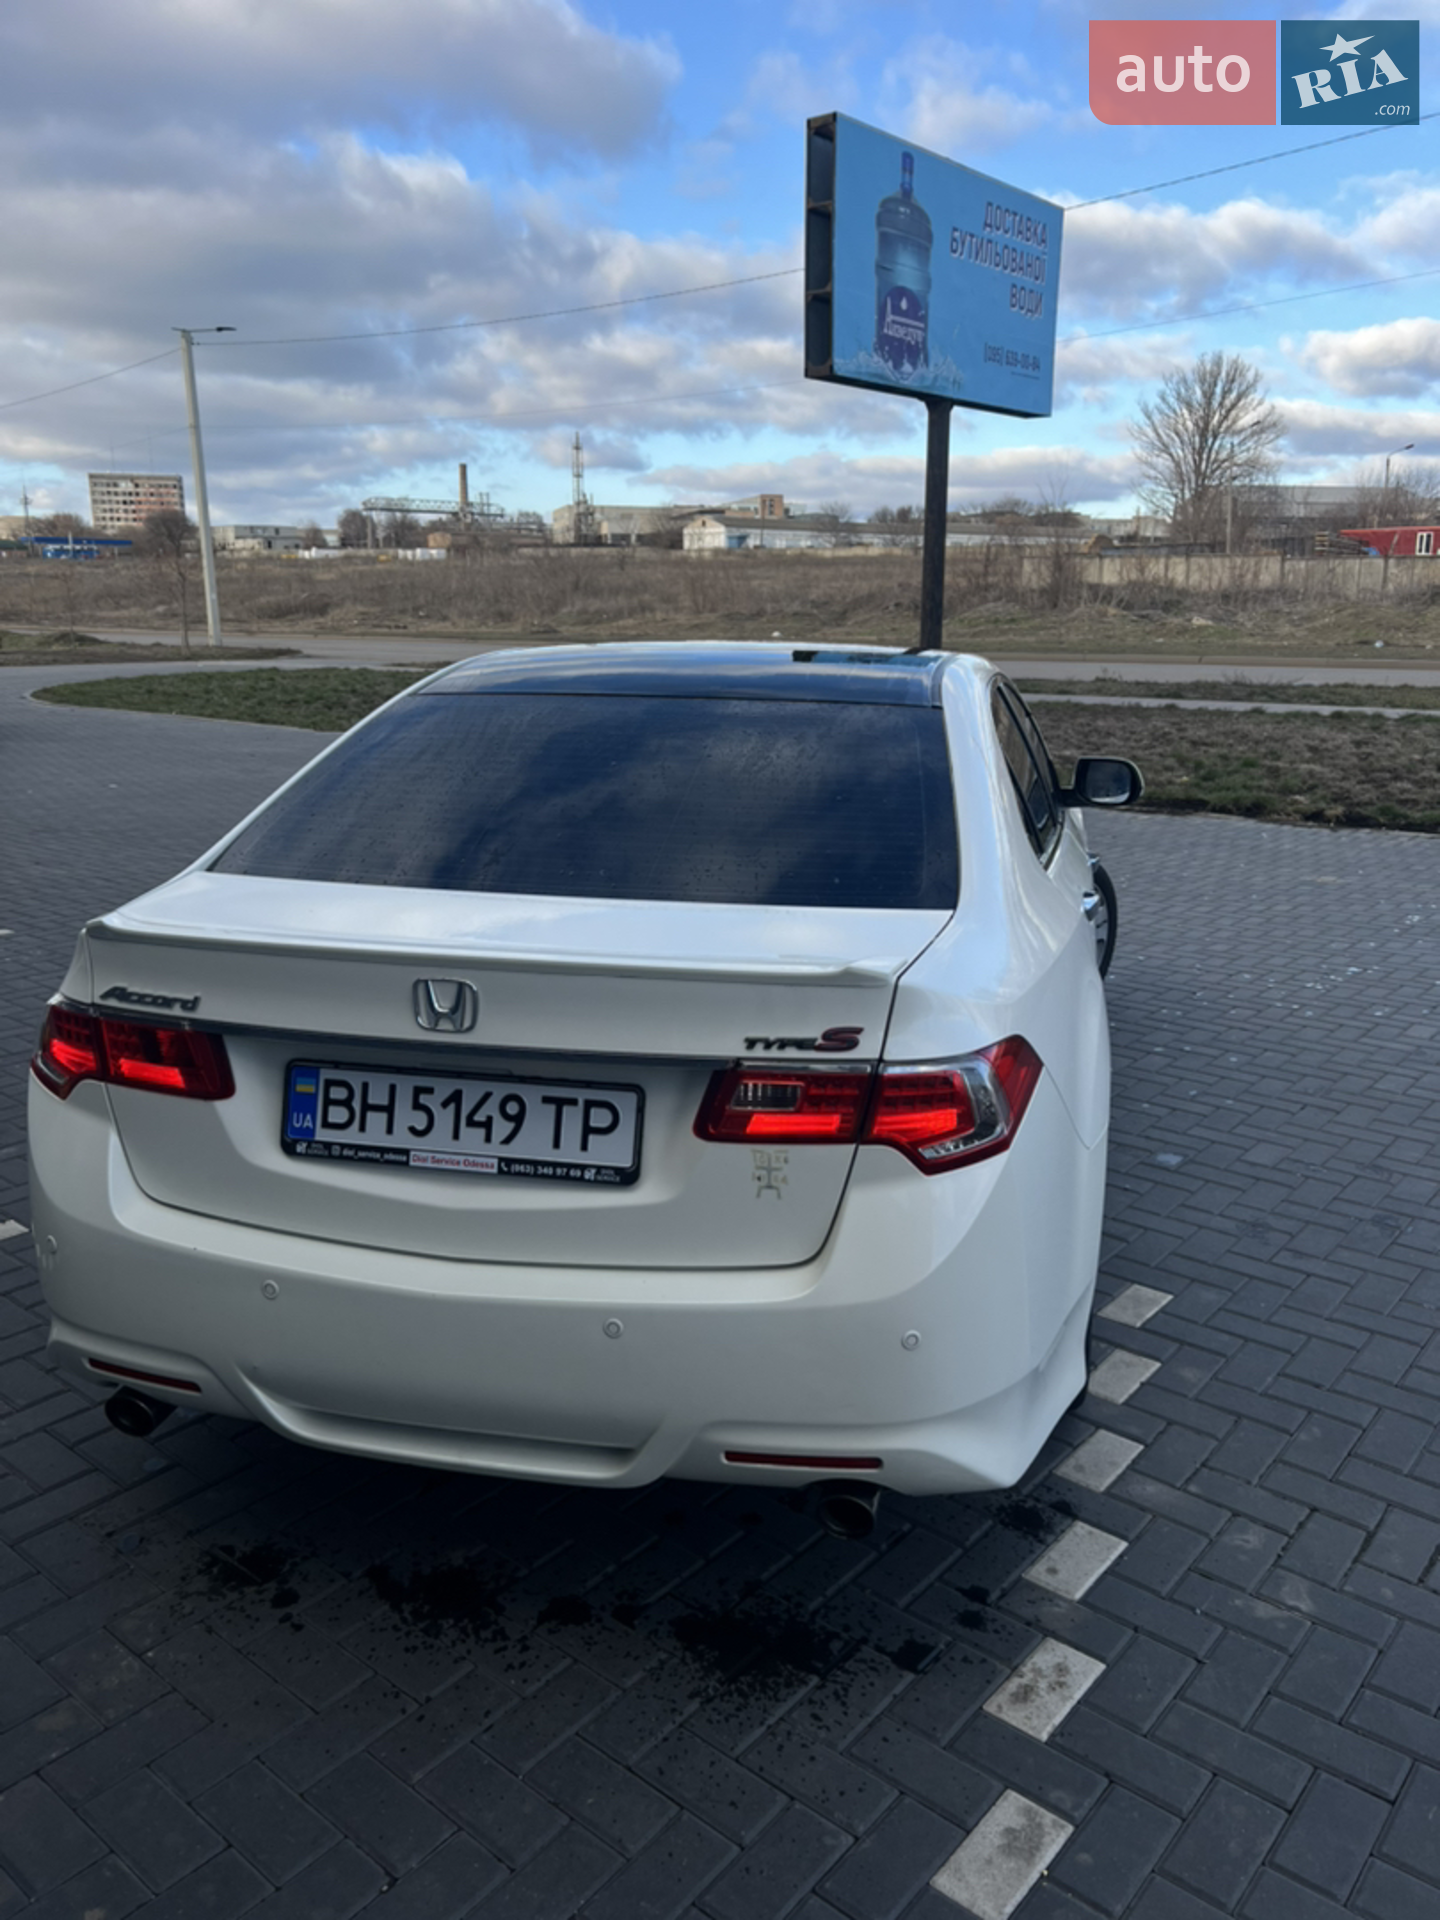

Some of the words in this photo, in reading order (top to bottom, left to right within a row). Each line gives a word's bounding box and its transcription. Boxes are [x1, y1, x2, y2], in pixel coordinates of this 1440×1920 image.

[983, 201, 1047, 249] ДОСТАВКА
[950, 226, 1047, 286] БУТИЛЬОВАНОЇ
[1009, 283, 1043, 318] ВОДИ
[99, 986, 201, 1012] Accord
[744, 1037, 818, 1051] TYPE
[814, 1026, 864, 1053] S
[292, 1112, 313, 1129] UA
[320, 1078, 397, 1136] BH
[407, 1085, 527, 1145] 5149
[541, 1095, 621, 1152] TP
